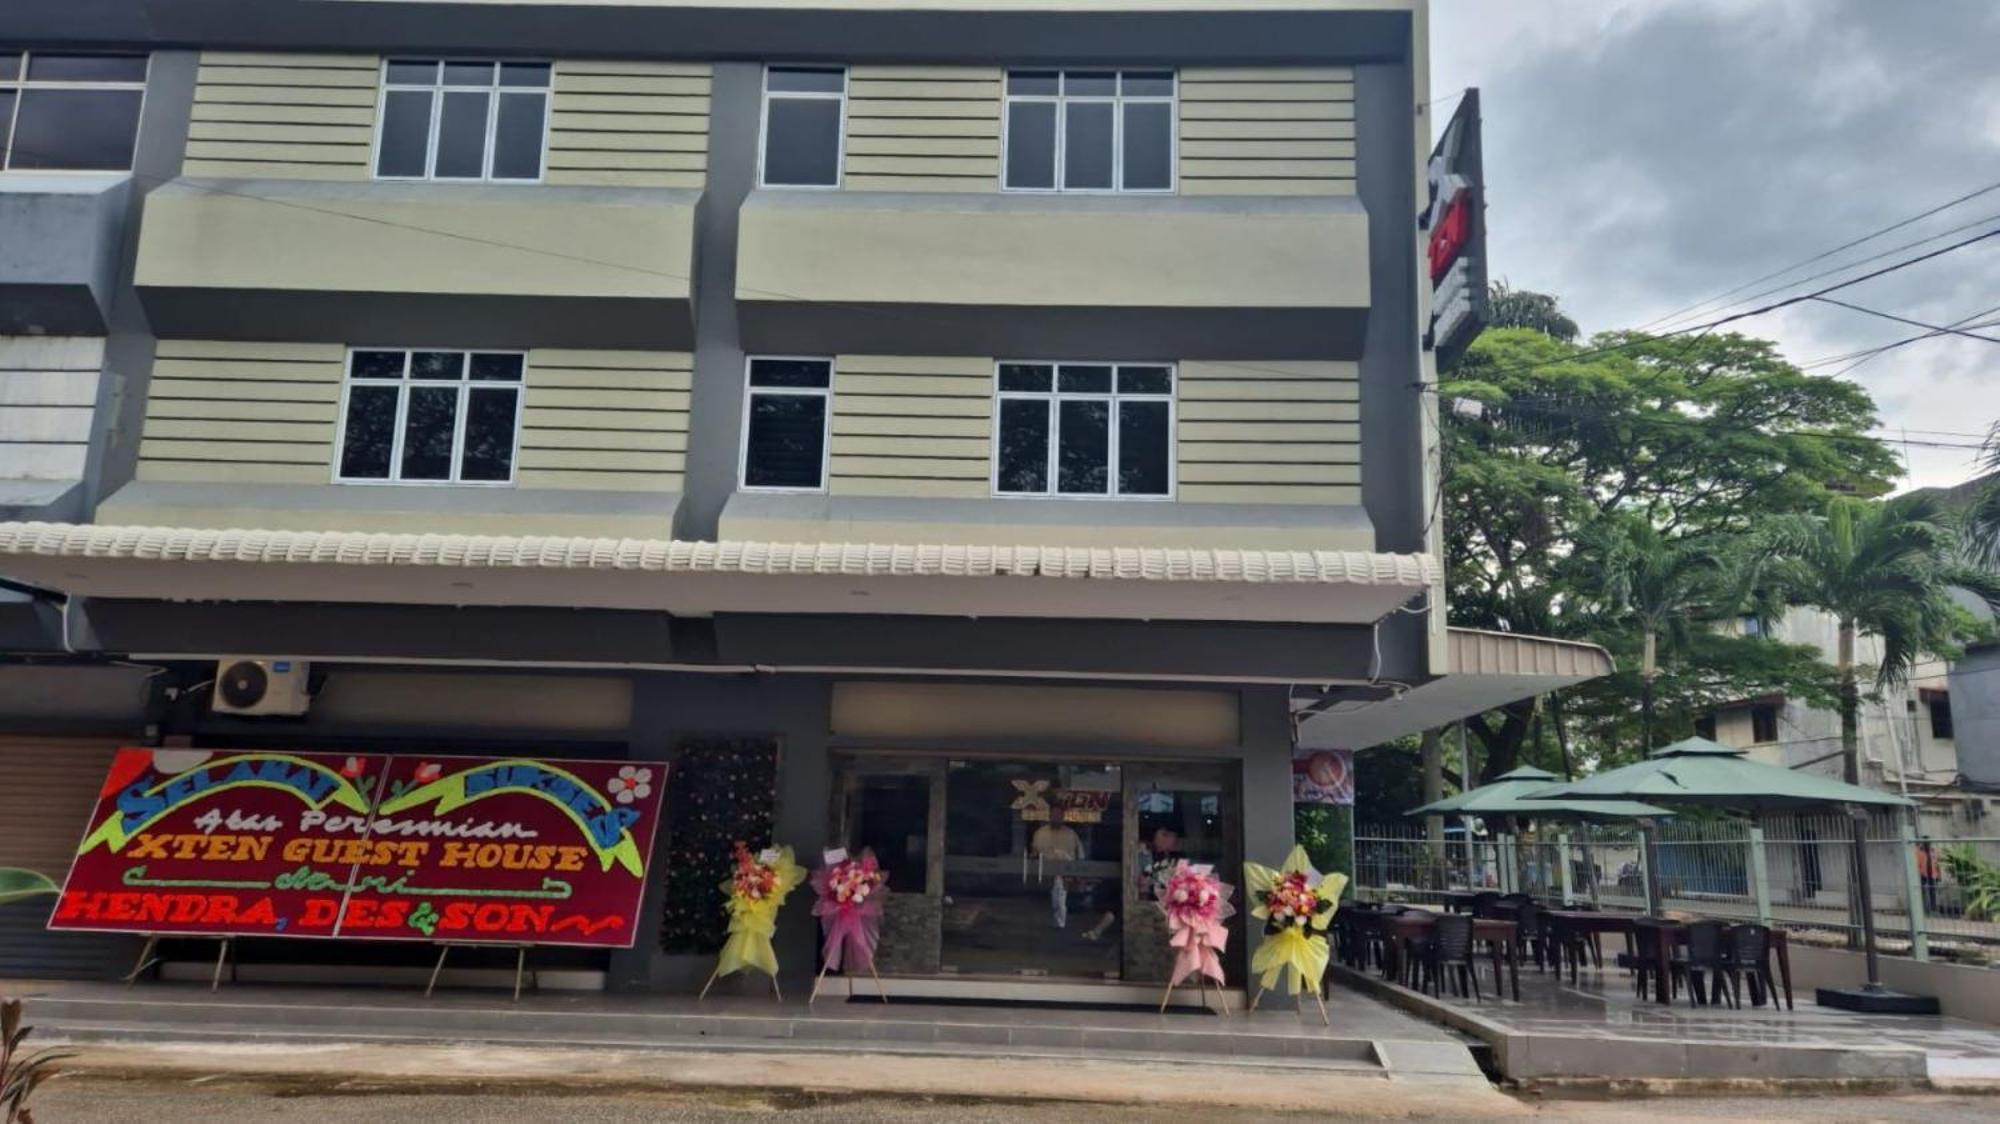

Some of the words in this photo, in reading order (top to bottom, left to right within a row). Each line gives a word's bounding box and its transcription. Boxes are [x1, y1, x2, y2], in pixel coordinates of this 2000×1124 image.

[116, 758, 342, 837] SELAMAT
[466, 764, 641, 849] SUKSES
[126, 833, 273, 860] XTEN
[283, 837, 429, 866] GUEST
[440, 840, 588, 871] HOUSE
